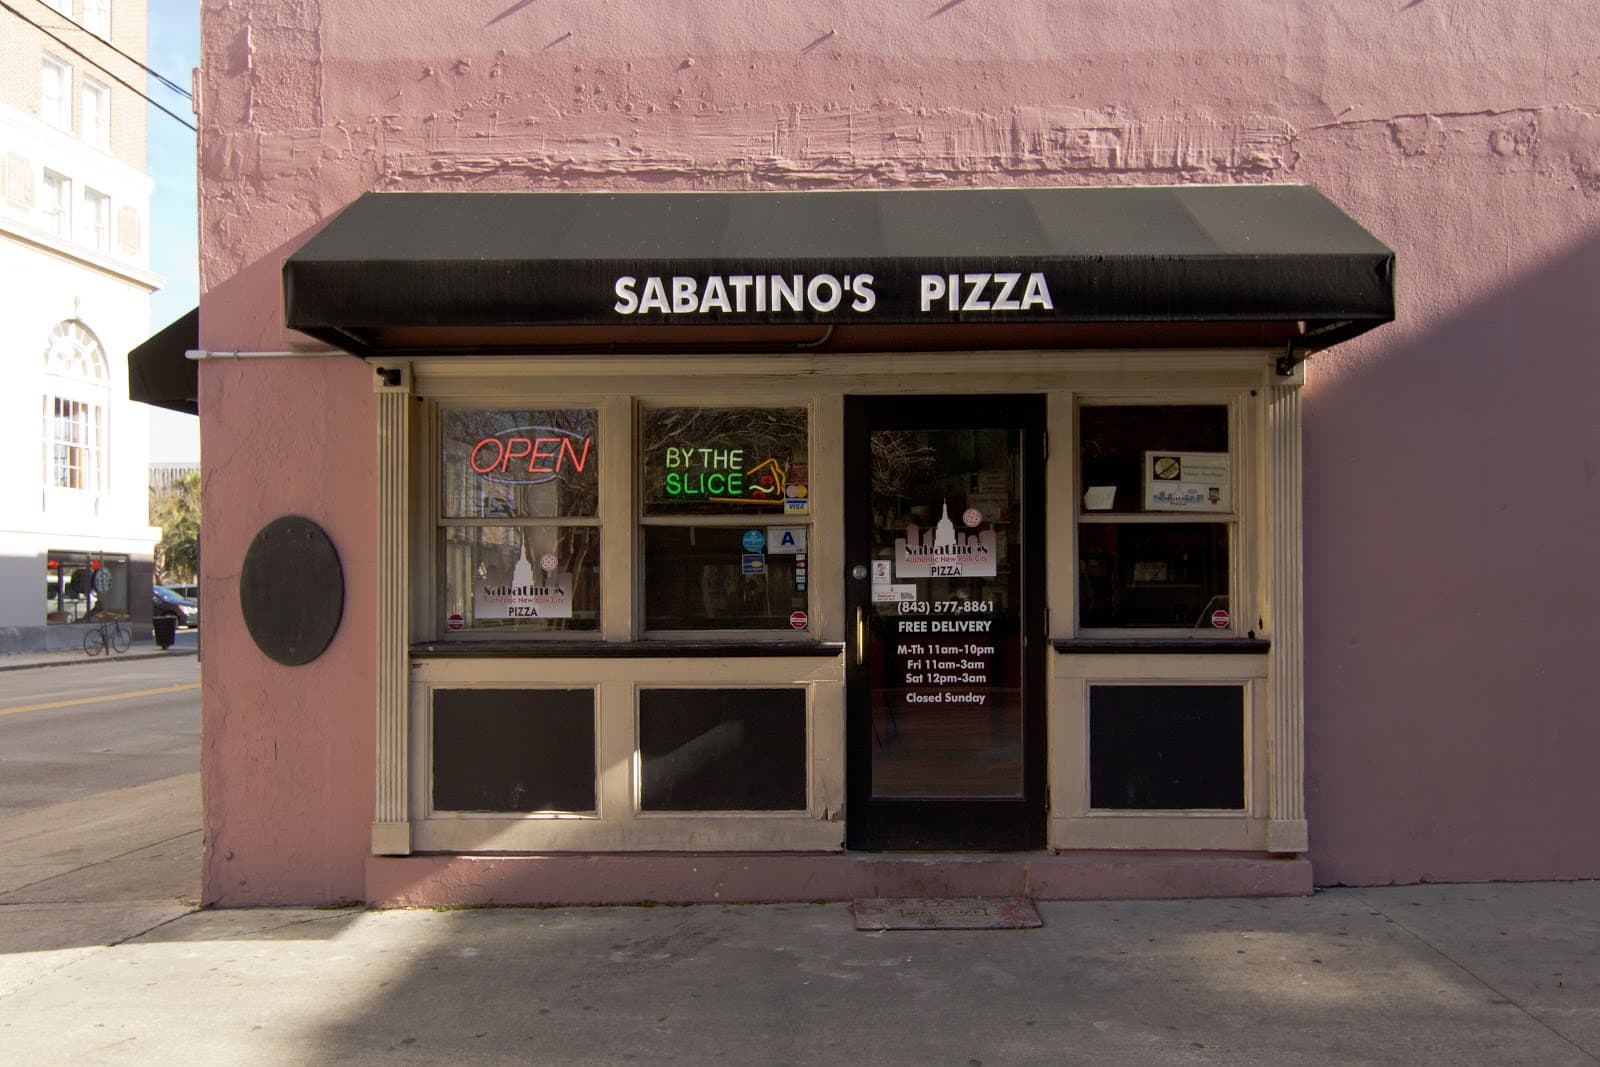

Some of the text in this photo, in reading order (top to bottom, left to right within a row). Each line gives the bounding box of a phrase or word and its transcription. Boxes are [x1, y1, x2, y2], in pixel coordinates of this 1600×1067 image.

[614, 272, 1054, 314] SABATINO'S PIZZA
[470, 437, 590, 473] OPEN
[666, 447, 743, 470] BY THE
[666, 473, 743, 495] SLICE
[781, 531, 795, 546] A
[975, 555, 988, 564] City
[931, 566, 961, 576] PIZZA
[508, 606, 538, 617] PIZZA
[897, 600, 994, 615] (843) 577-8861
[898, 621, 992, 632] FREE DELIVERY
[897, 644, 995, 657] M-Th 11am-10pm
[907, 659, 985, 670] Fri 11am-3am
[905, 672, 987, 685] Sat 12pm-3am
[906, 692, 986, 705] Closed Sunday
